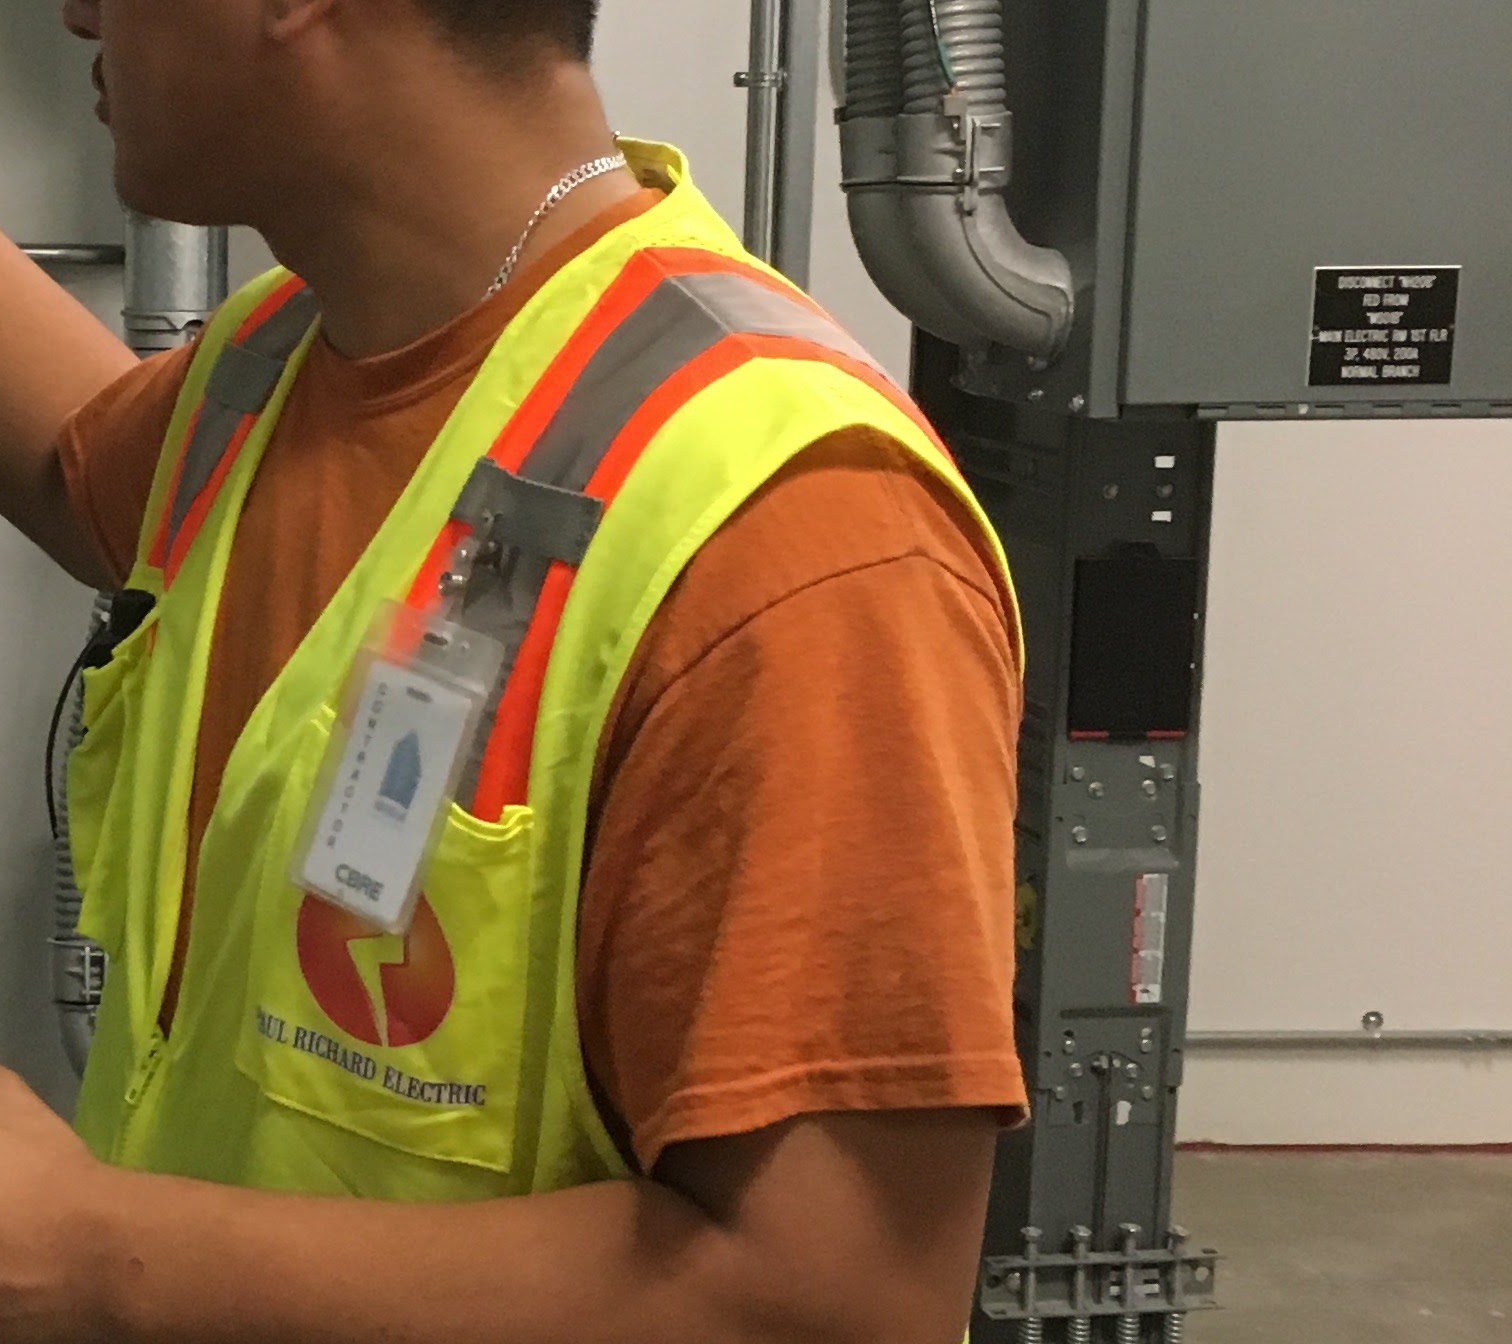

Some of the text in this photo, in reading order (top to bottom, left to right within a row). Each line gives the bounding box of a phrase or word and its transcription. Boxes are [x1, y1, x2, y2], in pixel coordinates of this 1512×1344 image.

[334, 863, 384, 902] CBRE
[292, 1026, 377, 1080] RICHARD
[382, 1065, 487, 1106] ELECTRIC
